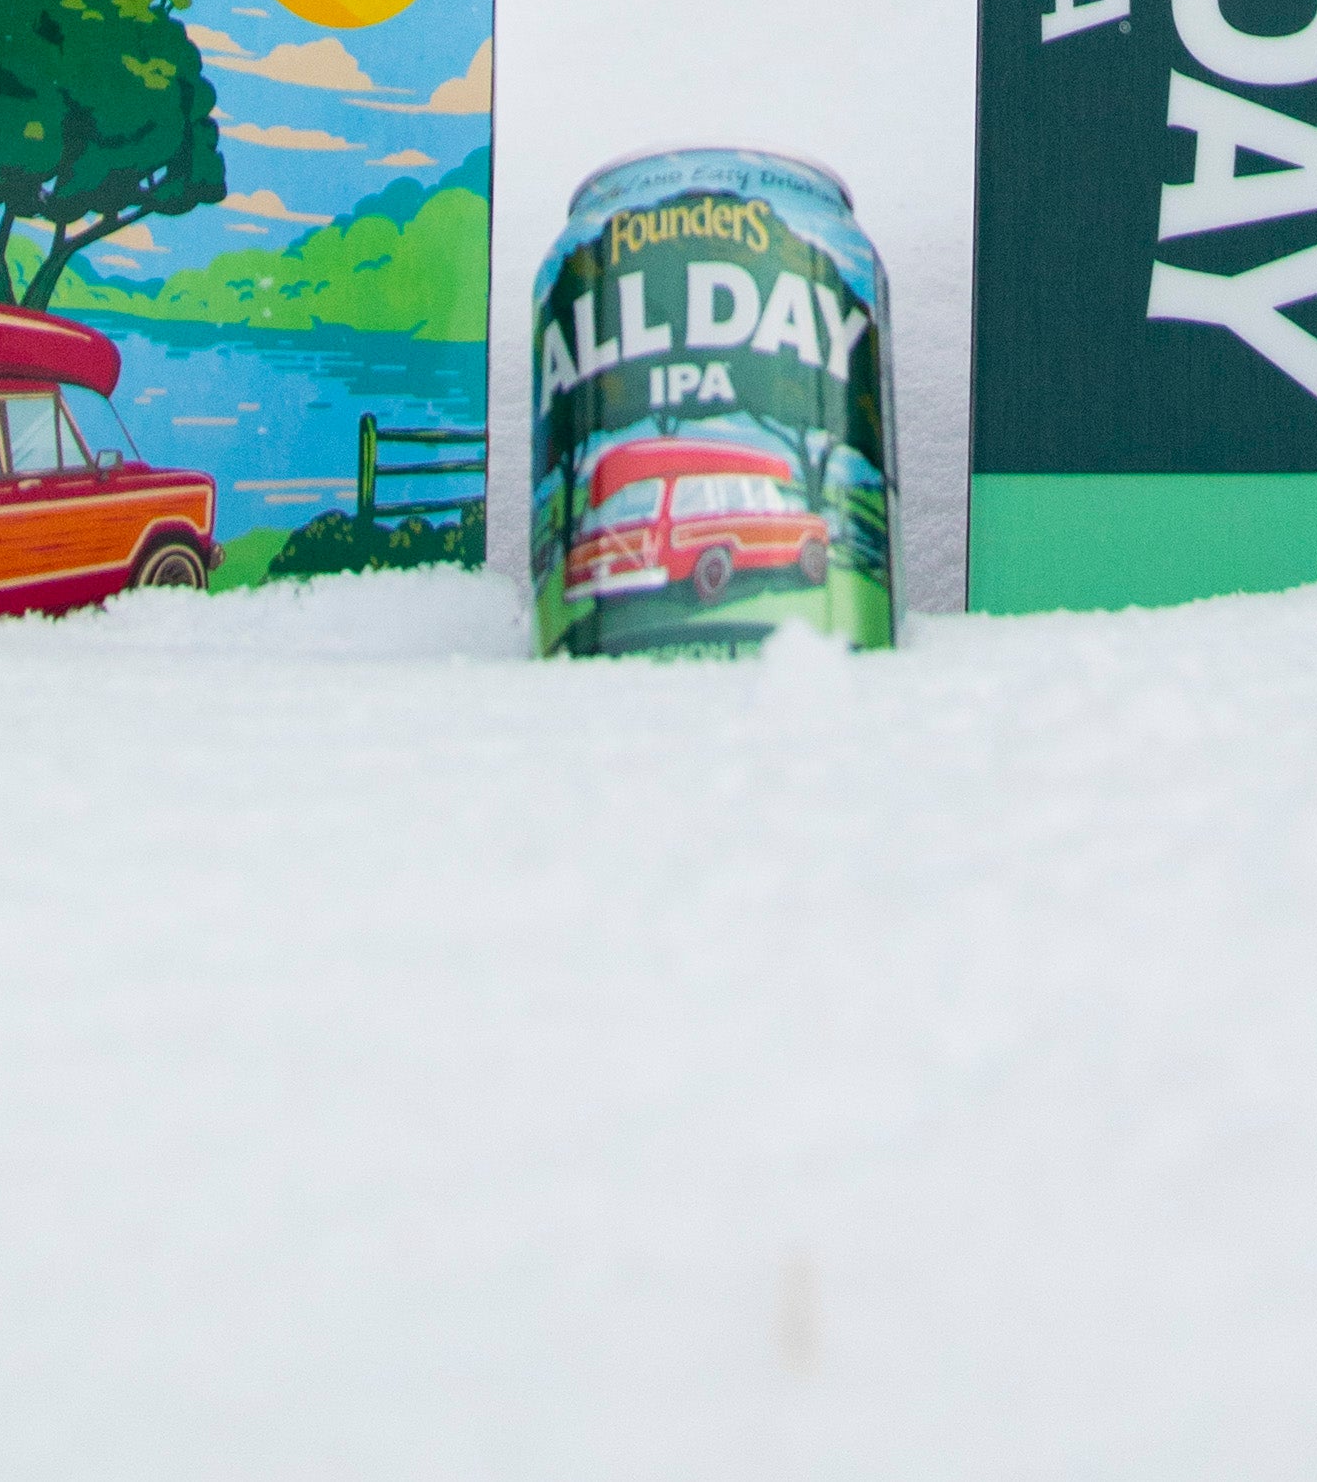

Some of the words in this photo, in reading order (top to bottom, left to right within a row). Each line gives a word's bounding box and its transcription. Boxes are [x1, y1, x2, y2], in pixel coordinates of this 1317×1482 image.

[538, 270, 674, 417] ALL
[684, 260, 871, 384] DAY
[649, 362, 737, 409] IPA
